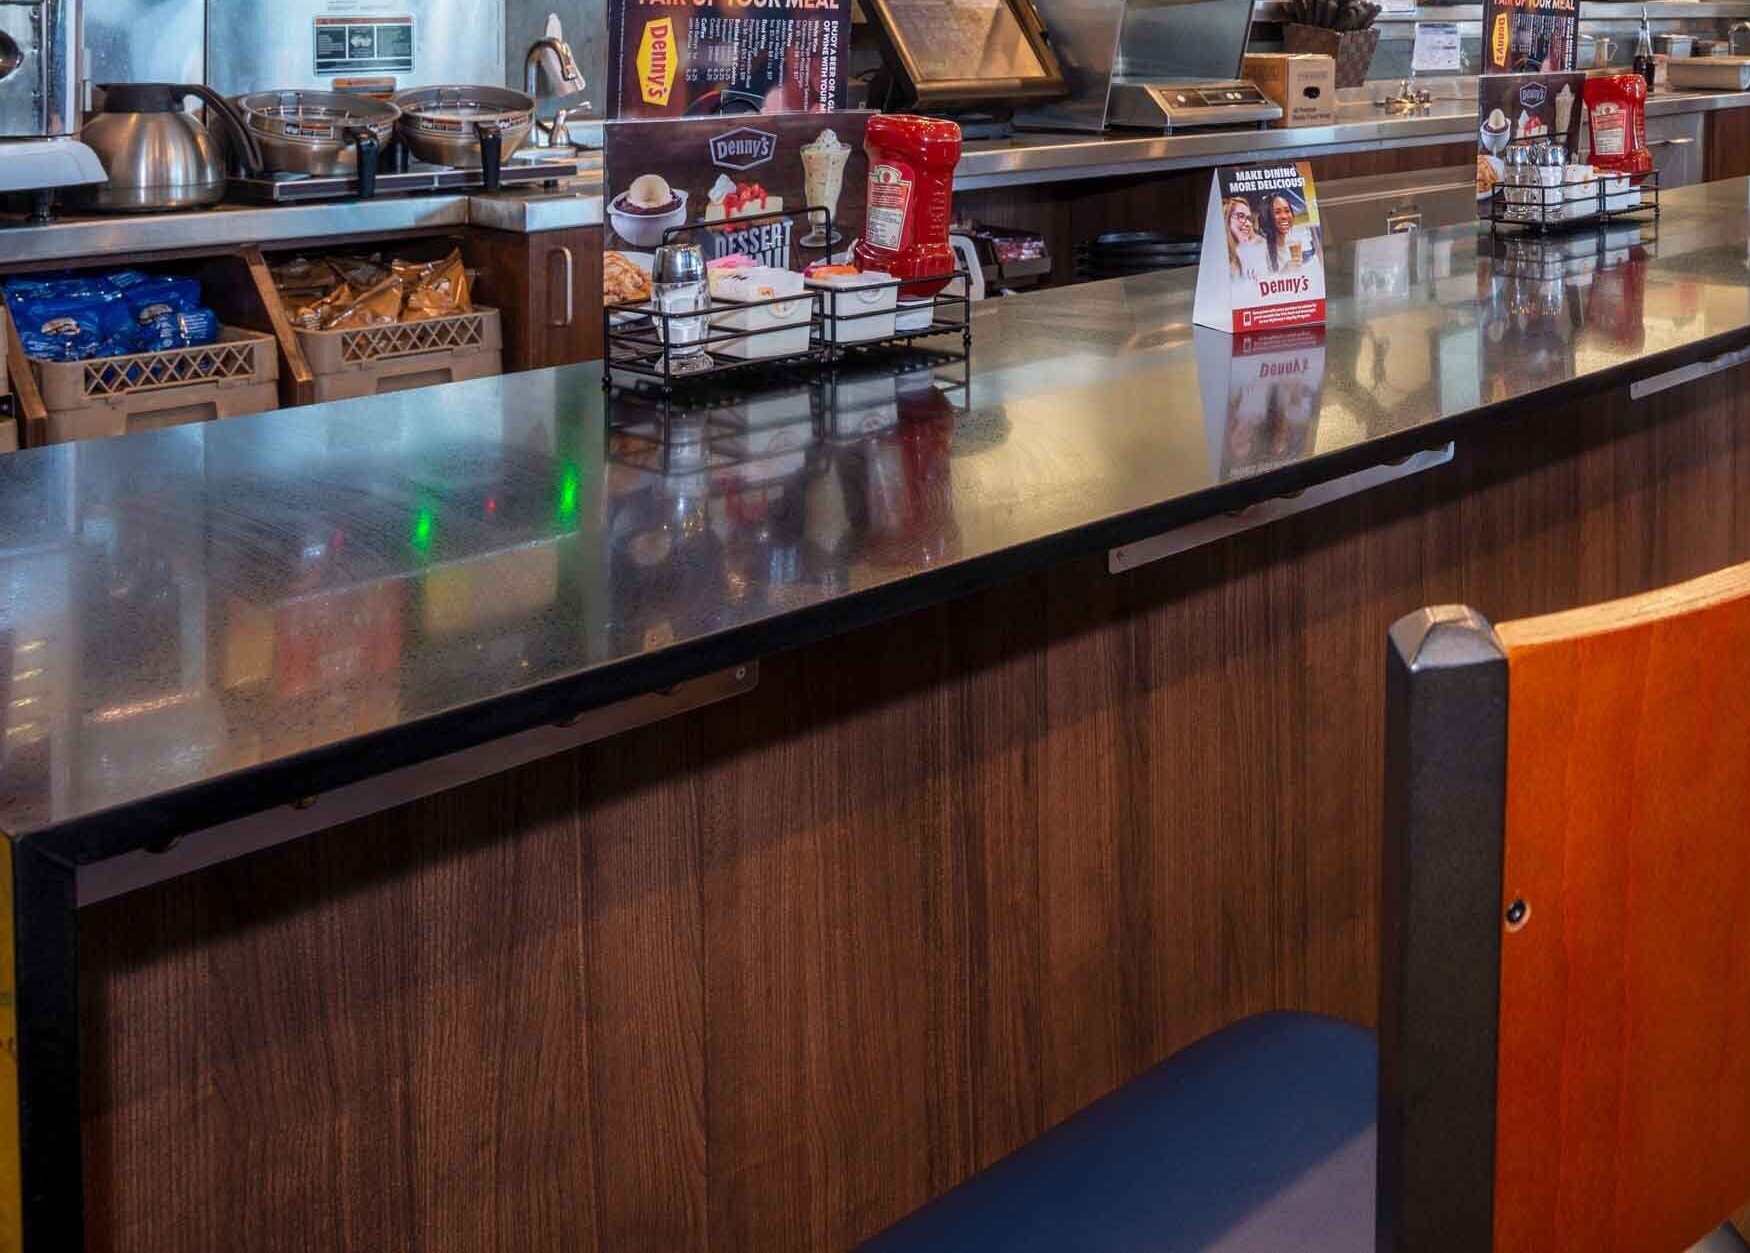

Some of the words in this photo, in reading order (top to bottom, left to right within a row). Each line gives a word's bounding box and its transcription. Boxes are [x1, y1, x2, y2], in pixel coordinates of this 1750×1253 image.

[823, 20, 831, 32] OF
[830, 20, 839, 48] ENJOY
[822, 33, 830, 55] WINE
[648, 25, 668, 99] Denny's
[820, 56, 829, 78] WITH
[829, 56, 837, 77] BEER
[820, 78, 828, 102] YOUR
[828, 78, 836, 92] OR
[717, 136, 770, 156] Denny's
[1230, 180, 1257, 193] MORE
[1257, 177, 1306, 191] DELICIOUS!
[1236, 170, 1263, 182] MAKE
[1264, 167, 1297, 179] DINING
[715, 220, 794, 258] DESSERT
[1259, 275, 1310, 296] Denny's
